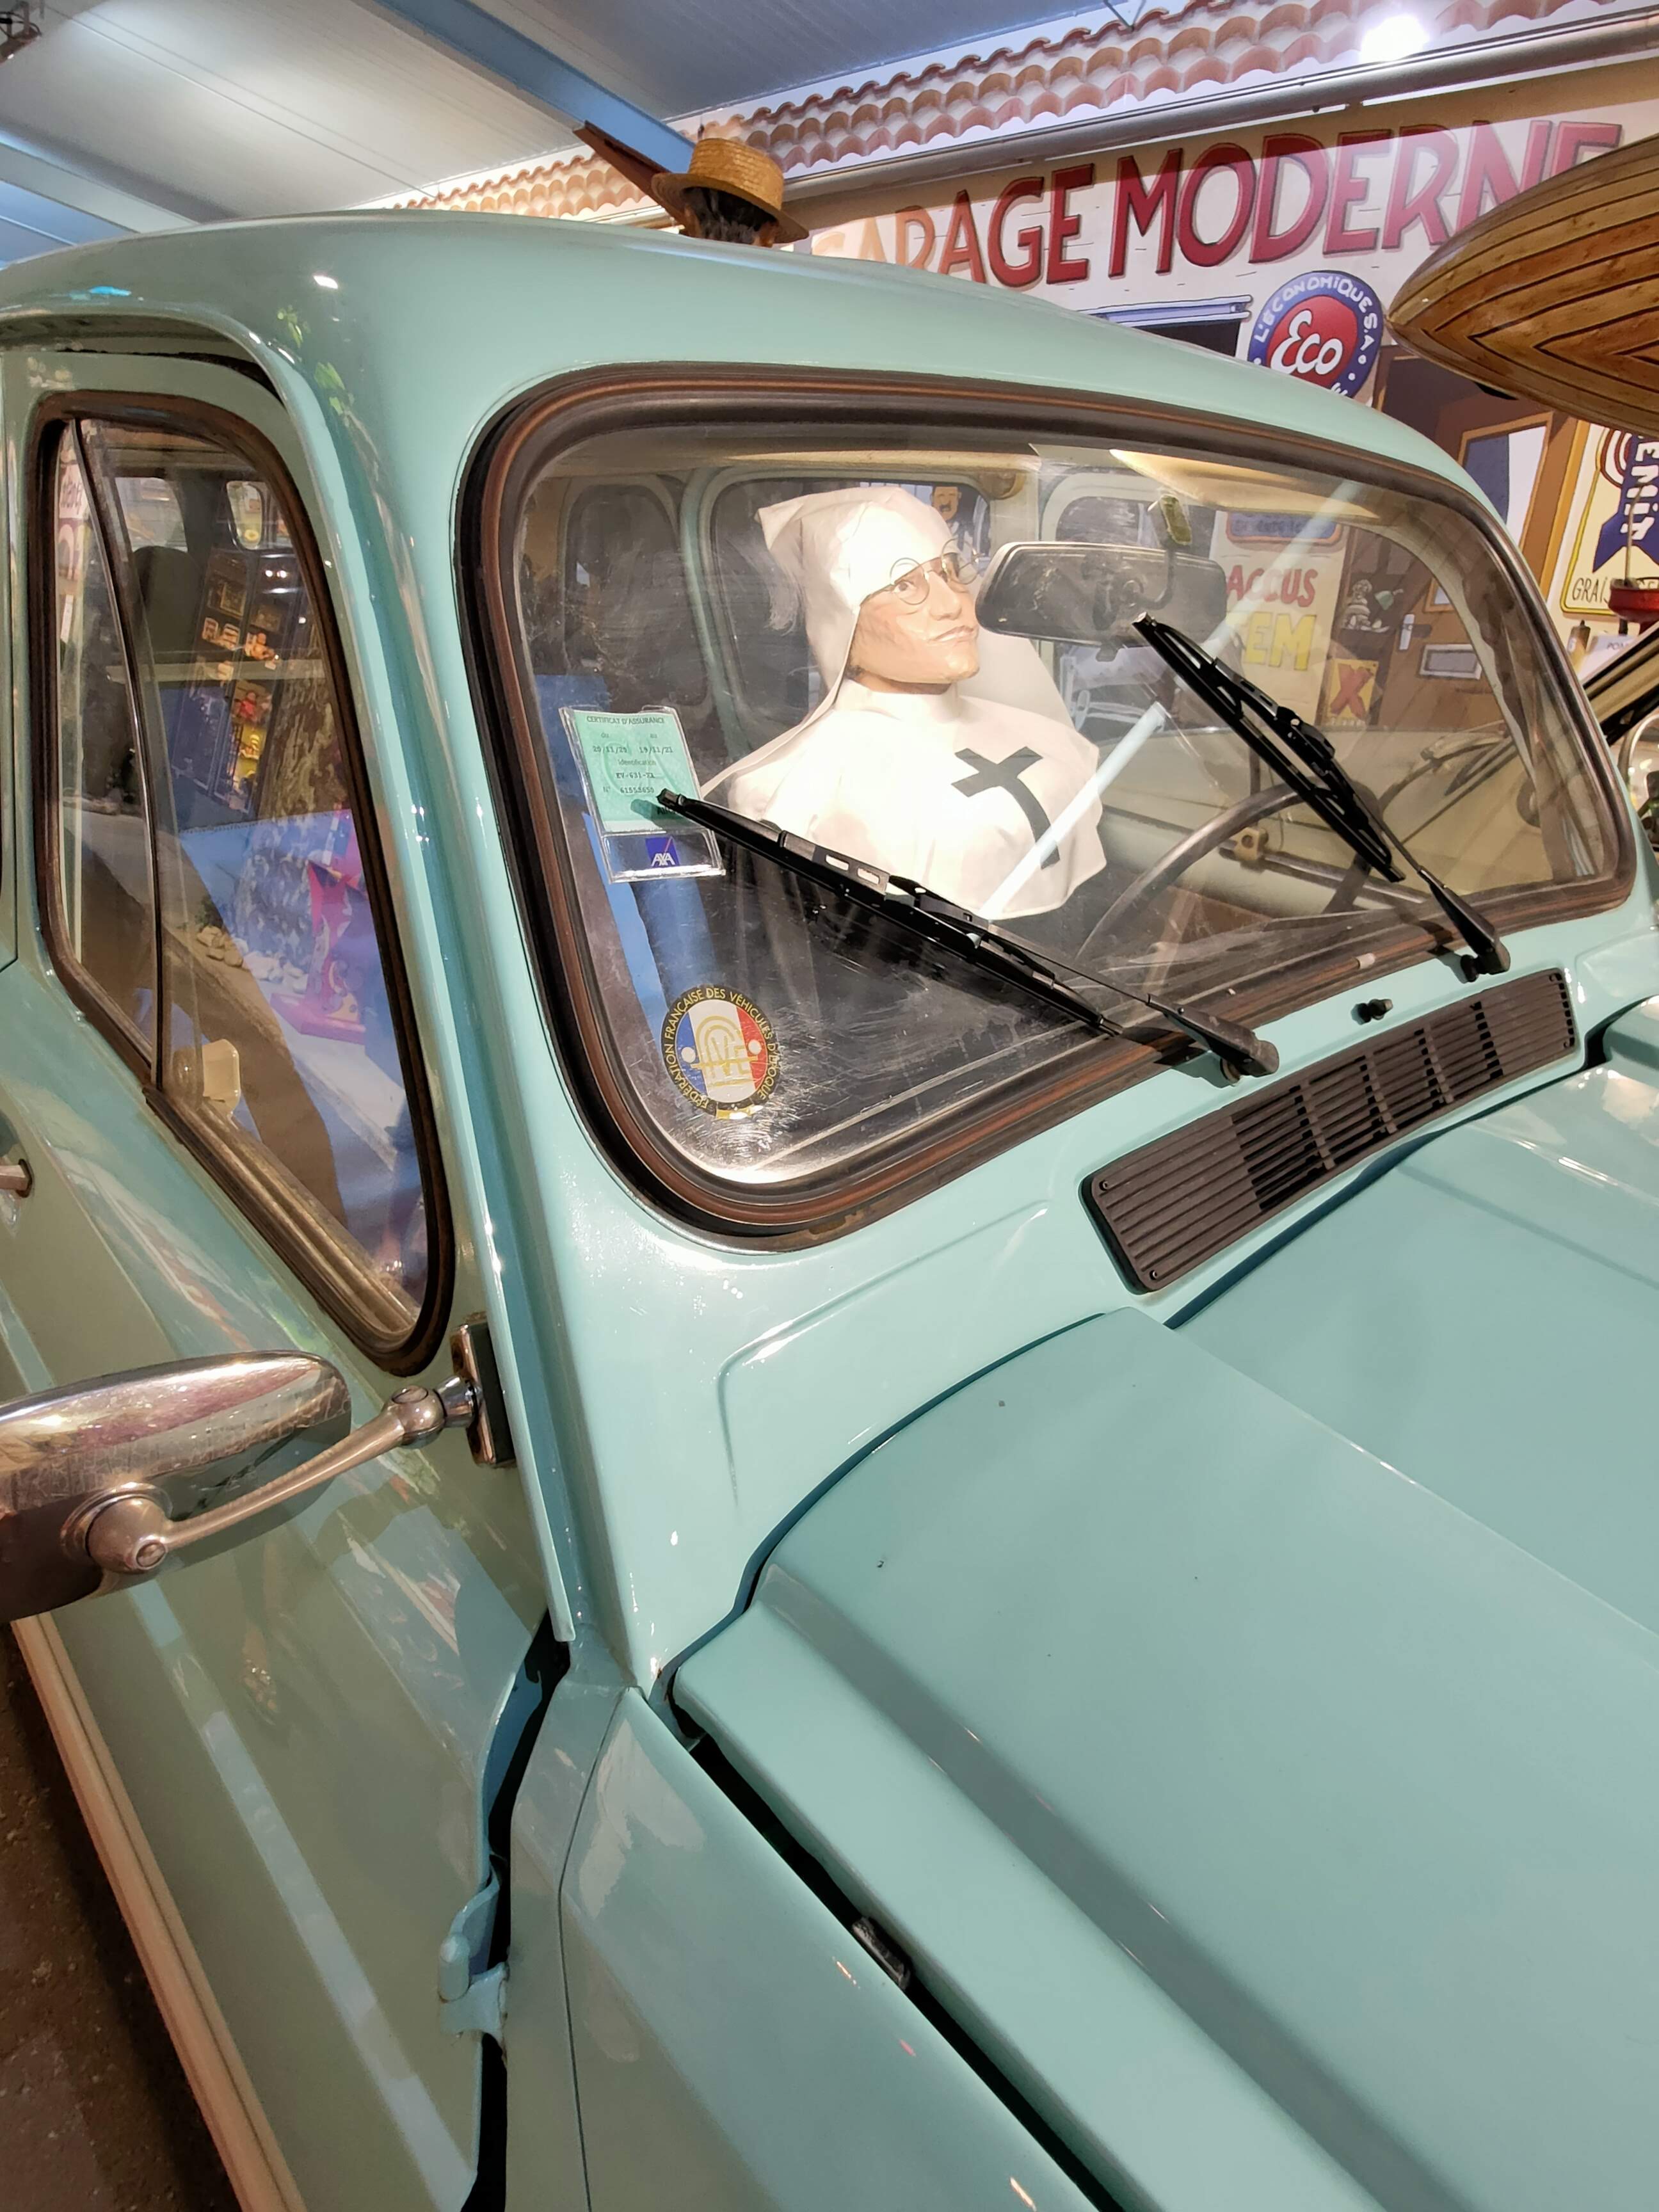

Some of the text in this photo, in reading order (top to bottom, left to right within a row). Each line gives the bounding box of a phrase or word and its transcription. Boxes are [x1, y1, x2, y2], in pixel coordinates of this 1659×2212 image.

[1270, 309, 1343, 375] Eco
[650, 852, 676, 867] AXA
[664, 989, 704, 1040] FRANÇAISE
[705, 987, 726, 999] DES
[730, 991, 773, 1041] VÉHICULES
